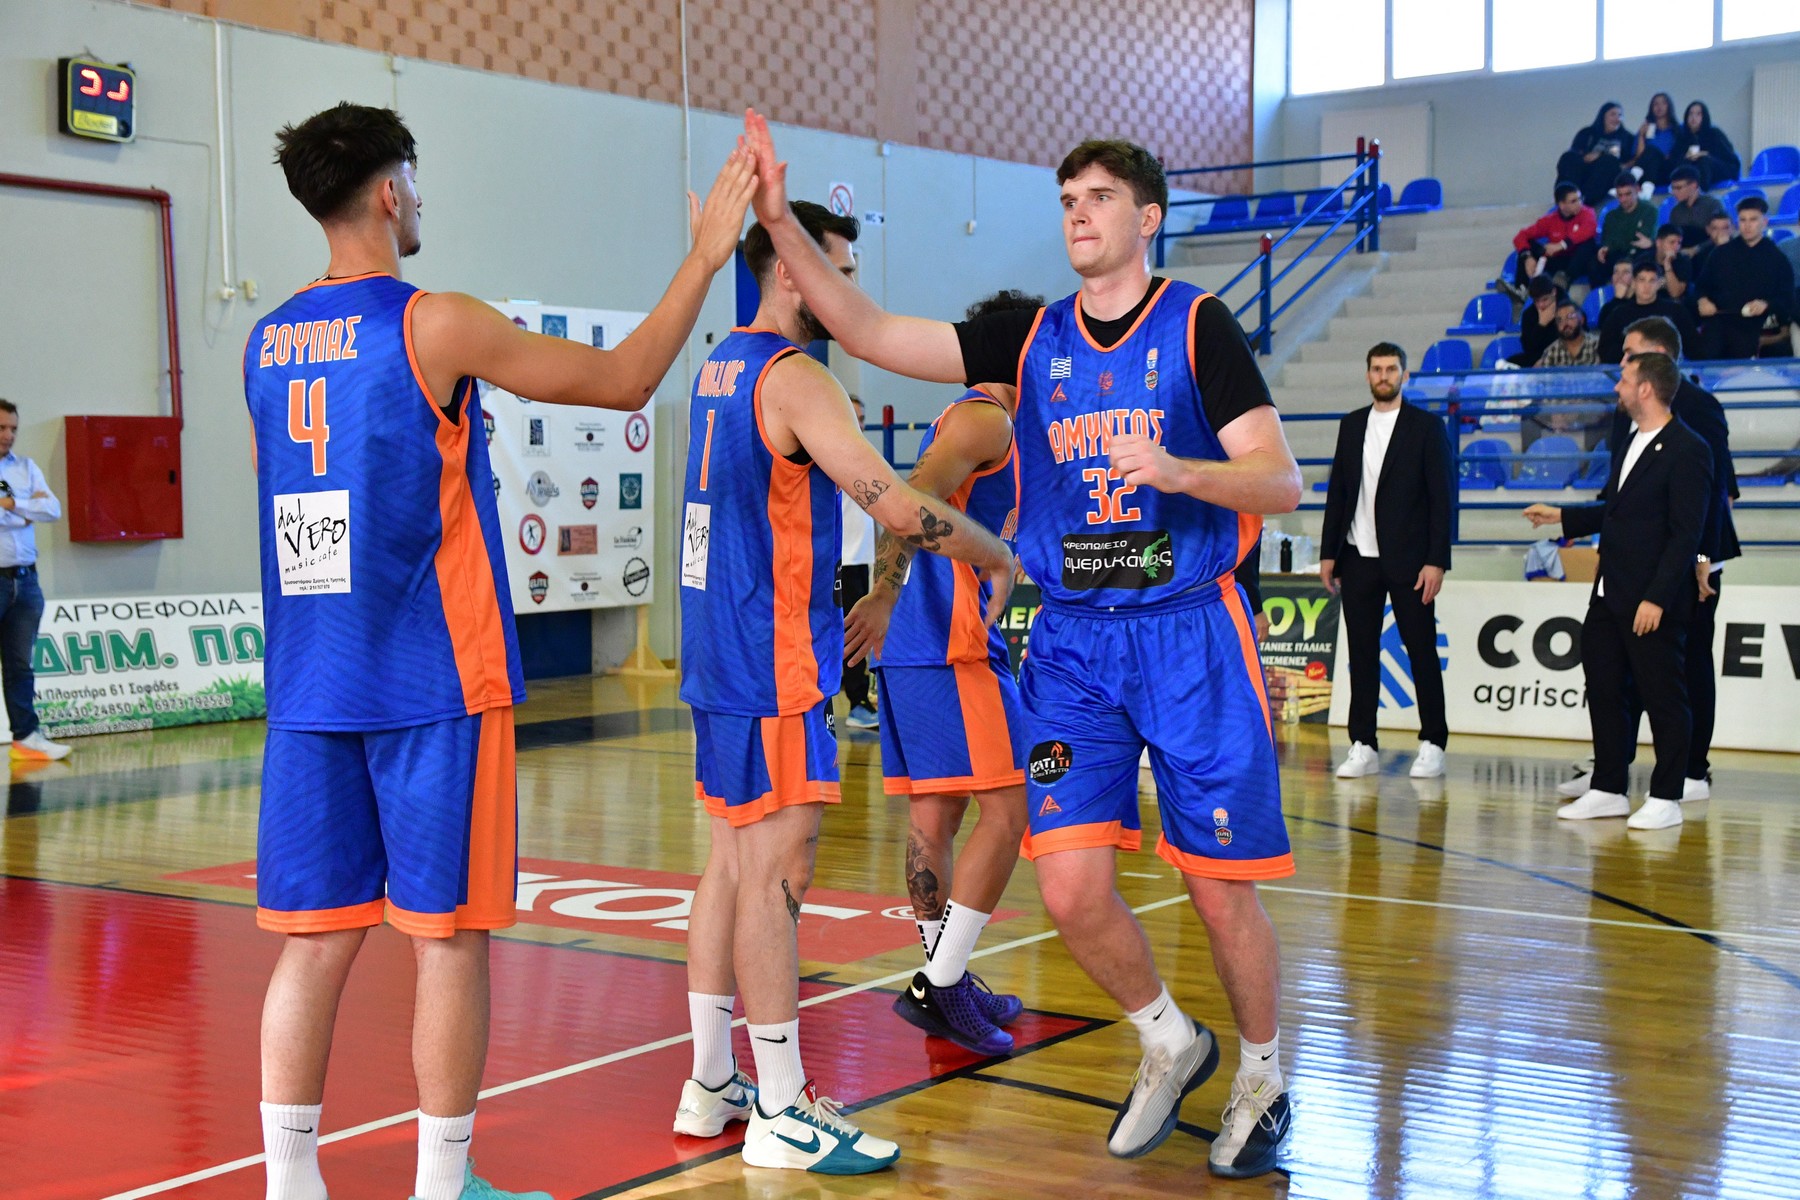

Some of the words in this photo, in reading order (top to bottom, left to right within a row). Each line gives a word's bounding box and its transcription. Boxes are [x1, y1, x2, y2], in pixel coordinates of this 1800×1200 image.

[260, 315, 362, 368] ΖΟΥΠΑΣ
[288, 377, 330, 476] 4
[699, 409, 715, 491] 1
[1082, 467, 1141, 525] 32
[278, 498, 305, 529] dal
[284, 517, 346, 558] VERO
[1063, 540, 1127, 550] ΚΡΕΟΠΩΛΕΙΟ
[285, 558, 315, 573] music
[319, 546, 338, 562] cafe
[1064, 548, 1173, 574] αμερικάνος
[54, 599, 245, 622] ΑΓΡΟΕΦΟΔΙΑ
[1262, 596, 1329, 641] ΟΥ
[33, 627, 179, 678] ΔΗΜ.
[188, 622, 264, 667] ΠΩ
[1260, 642, 1293, 652] ΤΑΝΙΕΣ
[1261, 656, 1307, 666] ΝΙΣΜΕΝΕΣ
[46, 685, 107, 700] Πλαστήρα
[109, 683, 125, 695] 61
[129, 680, 179, 695] Σοφάδες
[1474, 679, 1588, 712] agrisci
